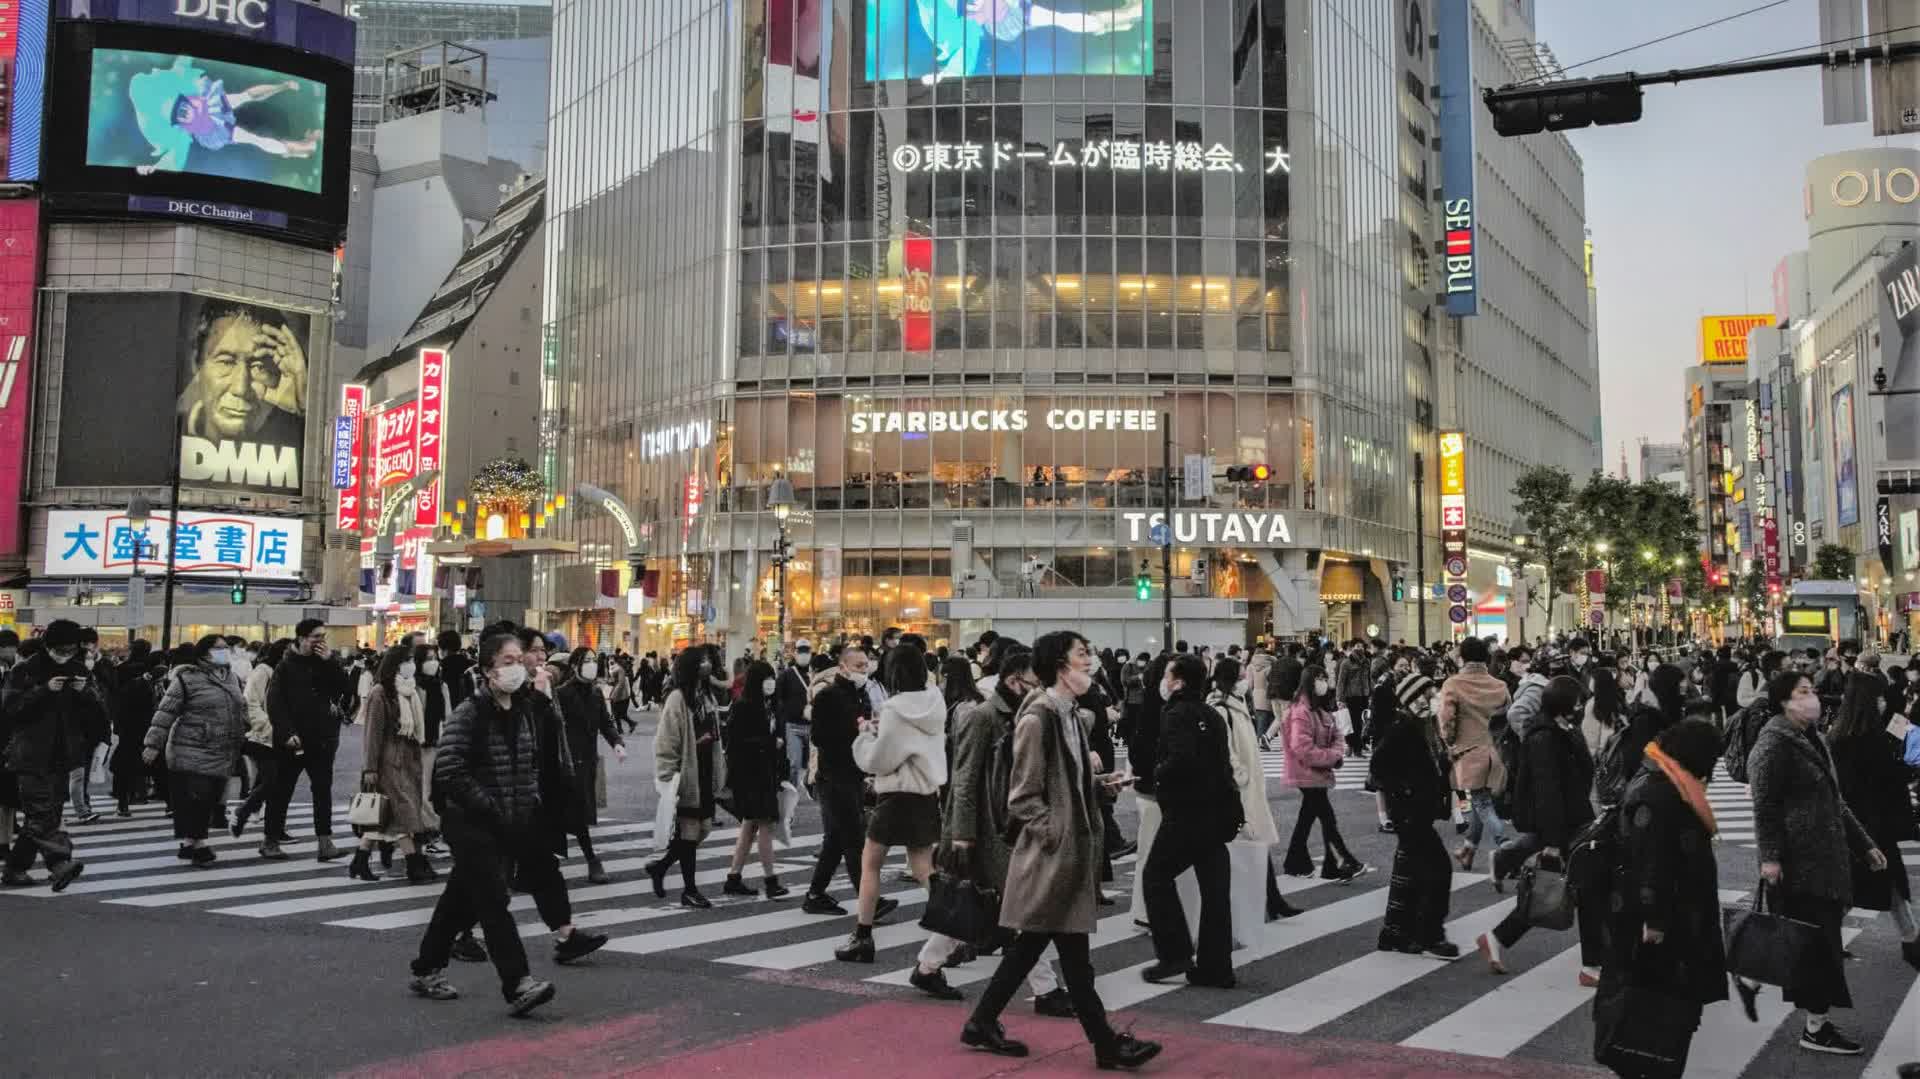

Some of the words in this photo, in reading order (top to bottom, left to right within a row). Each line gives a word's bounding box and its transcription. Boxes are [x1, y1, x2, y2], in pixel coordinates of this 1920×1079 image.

[168, 201, 199, 214] DHC
[201, 204, 253, 221] Channel
[1445, 199, 1473, 294] SEIBU
[1887, 264, 1920, 319] ZAR
[380, 408, 416, 442] カラオケ
[421, 362, 441, 447] カラオケ
[851, 410, 1028, 433] STARBUCKS
[1046, 409, 1157, 431] COFFEE
[1745, 400, 1759, 461] KARAOKE
[180, 436, 299, 489] DMM
[62, 523, 288, 565] 大盛堂書店
[1878, 505, 1890, 545] ZARA
